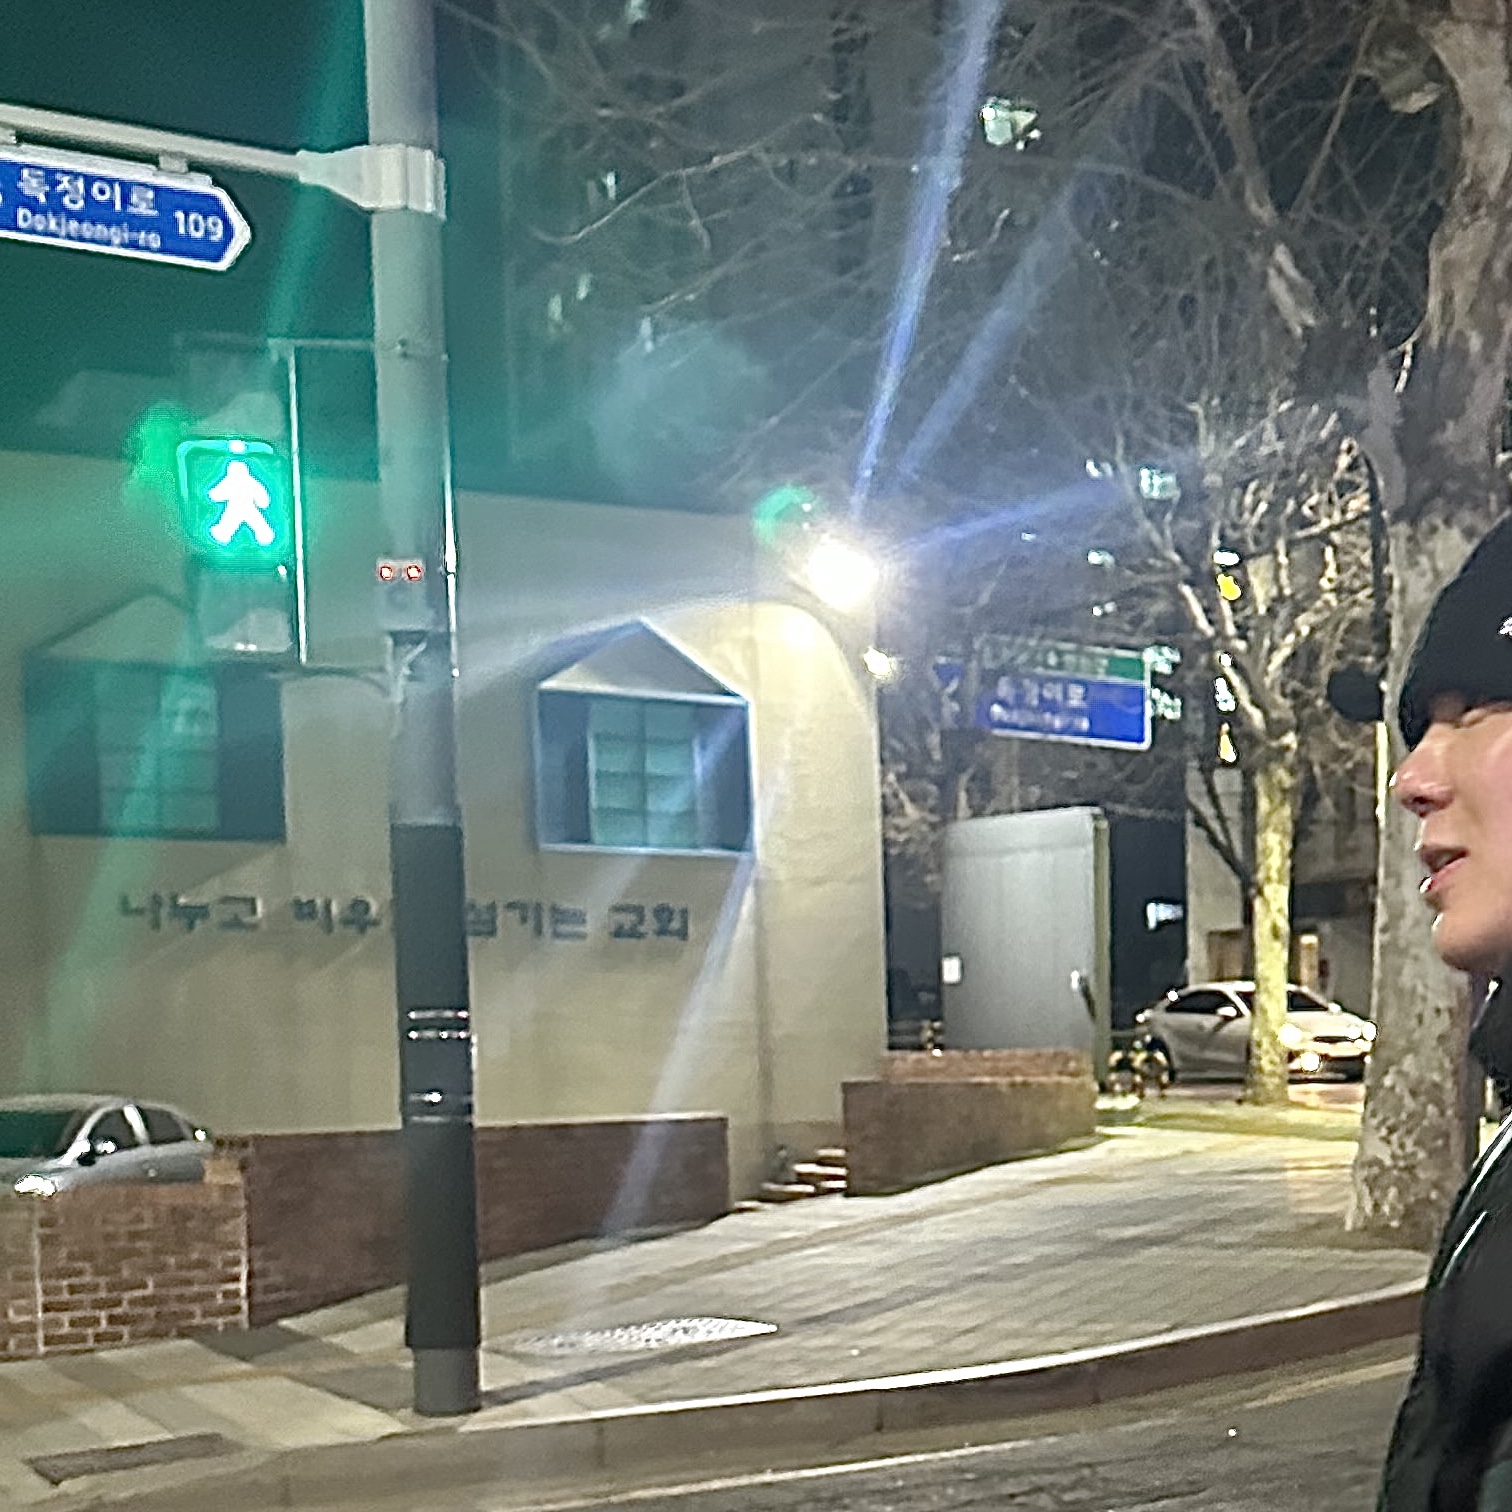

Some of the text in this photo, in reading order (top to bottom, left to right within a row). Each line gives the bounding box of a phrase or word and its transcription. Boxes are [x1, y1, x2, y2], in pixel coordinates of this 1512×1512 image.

[17, 168, 159, 217] 독정이로
[173, 209, 224, 243] 109
[117, 894, 263, 934] 나누고
[293, 895, 382, 935] 비우
[608, 902, 690, 942] 교회
